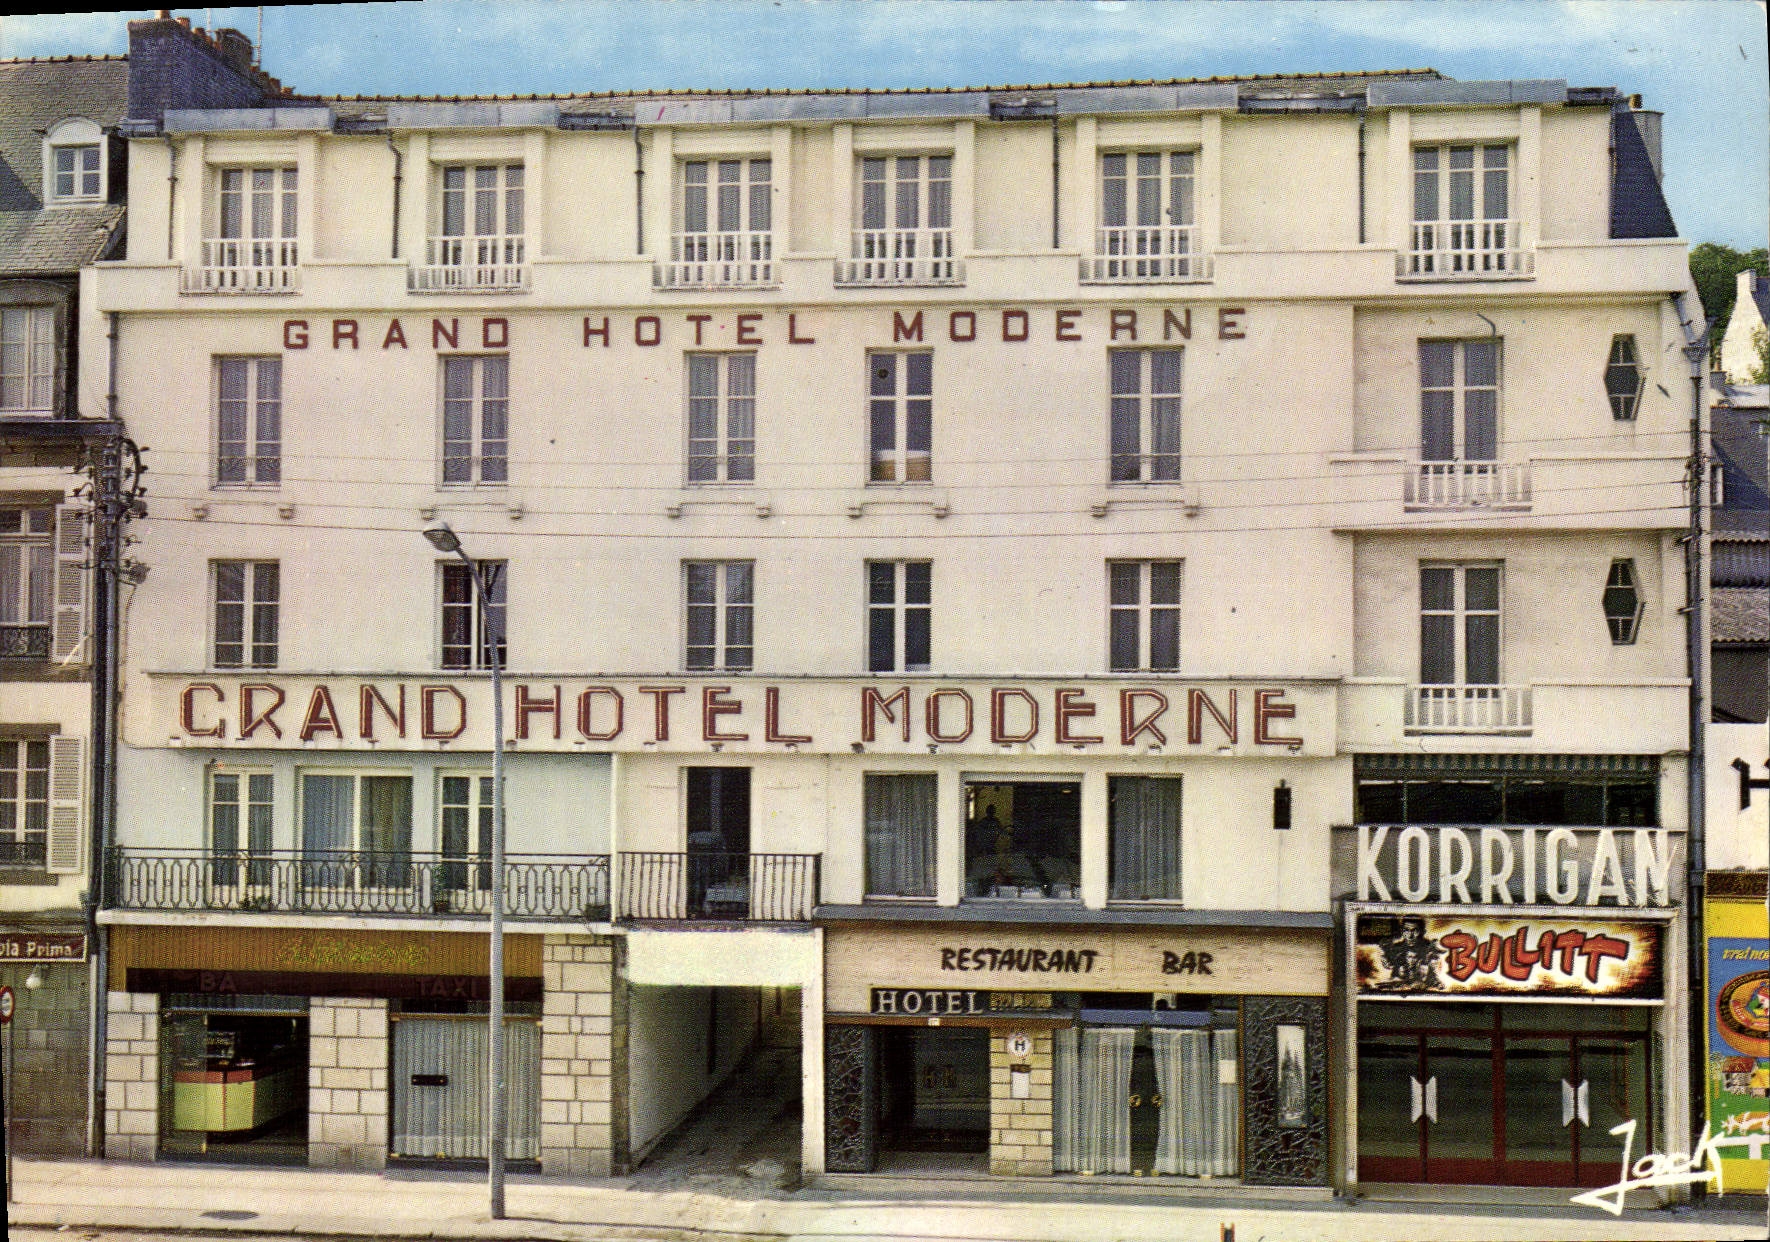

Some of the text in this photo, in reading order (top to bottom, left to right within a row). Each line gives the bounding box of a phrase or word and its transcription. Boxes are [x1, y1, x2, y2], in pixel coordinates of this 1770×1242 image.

[283, 308, 1246, 350] GRAND HOTEL MODERNE
[179, 682, 1305, 747] GRAND HOTEL MODERNE
[1356, 825, 1670, 906] KORRIGAN
[940, 947, 1214, 975] RESTAURANT BAR
[1440, 926, 1630, 984] BULLITT
[876, 989, 984, 1015] HOTEL
